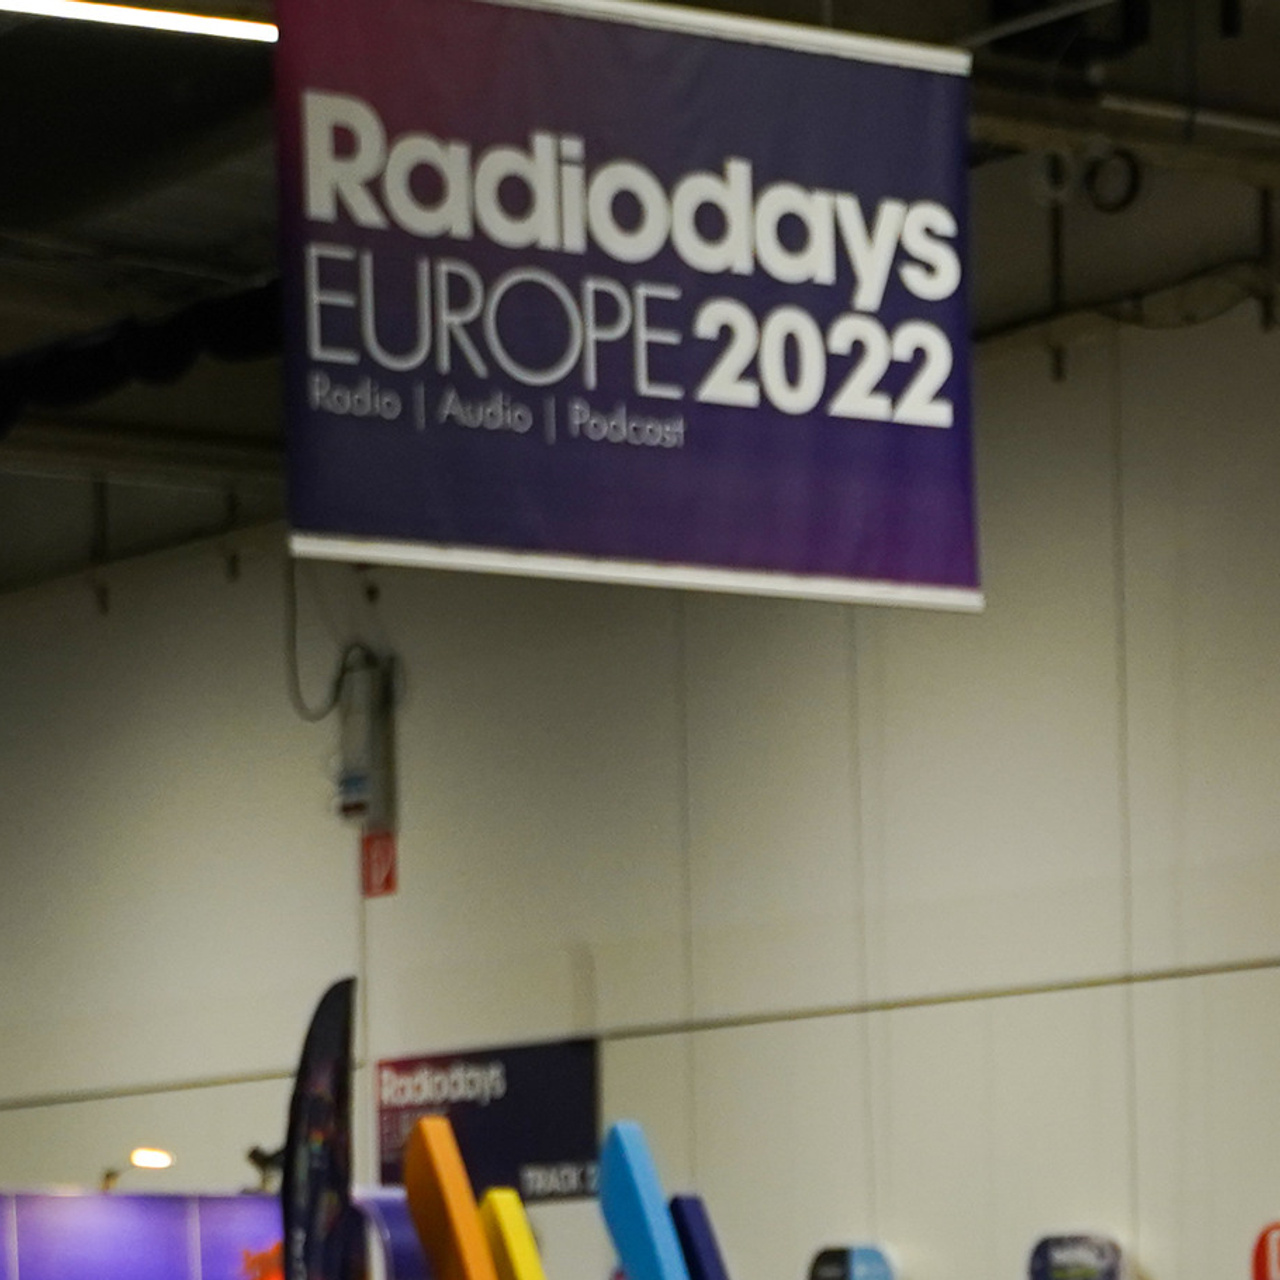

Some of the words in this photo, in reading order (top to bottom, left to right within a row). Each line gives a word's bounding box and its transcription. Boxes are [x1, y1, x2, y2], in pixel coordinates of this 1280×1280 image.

[302, 89, 962, 313] Radiodays
[306, 241, 684, 400] EUROPE
[693, 297, 955, 428] 2022
[308, 370, 402, 421] Radio
[438, 386, 533, 434] Audio
[568, 397, 685, 449] Podcast
[381, 1060, 507, 1107] Radiodays
